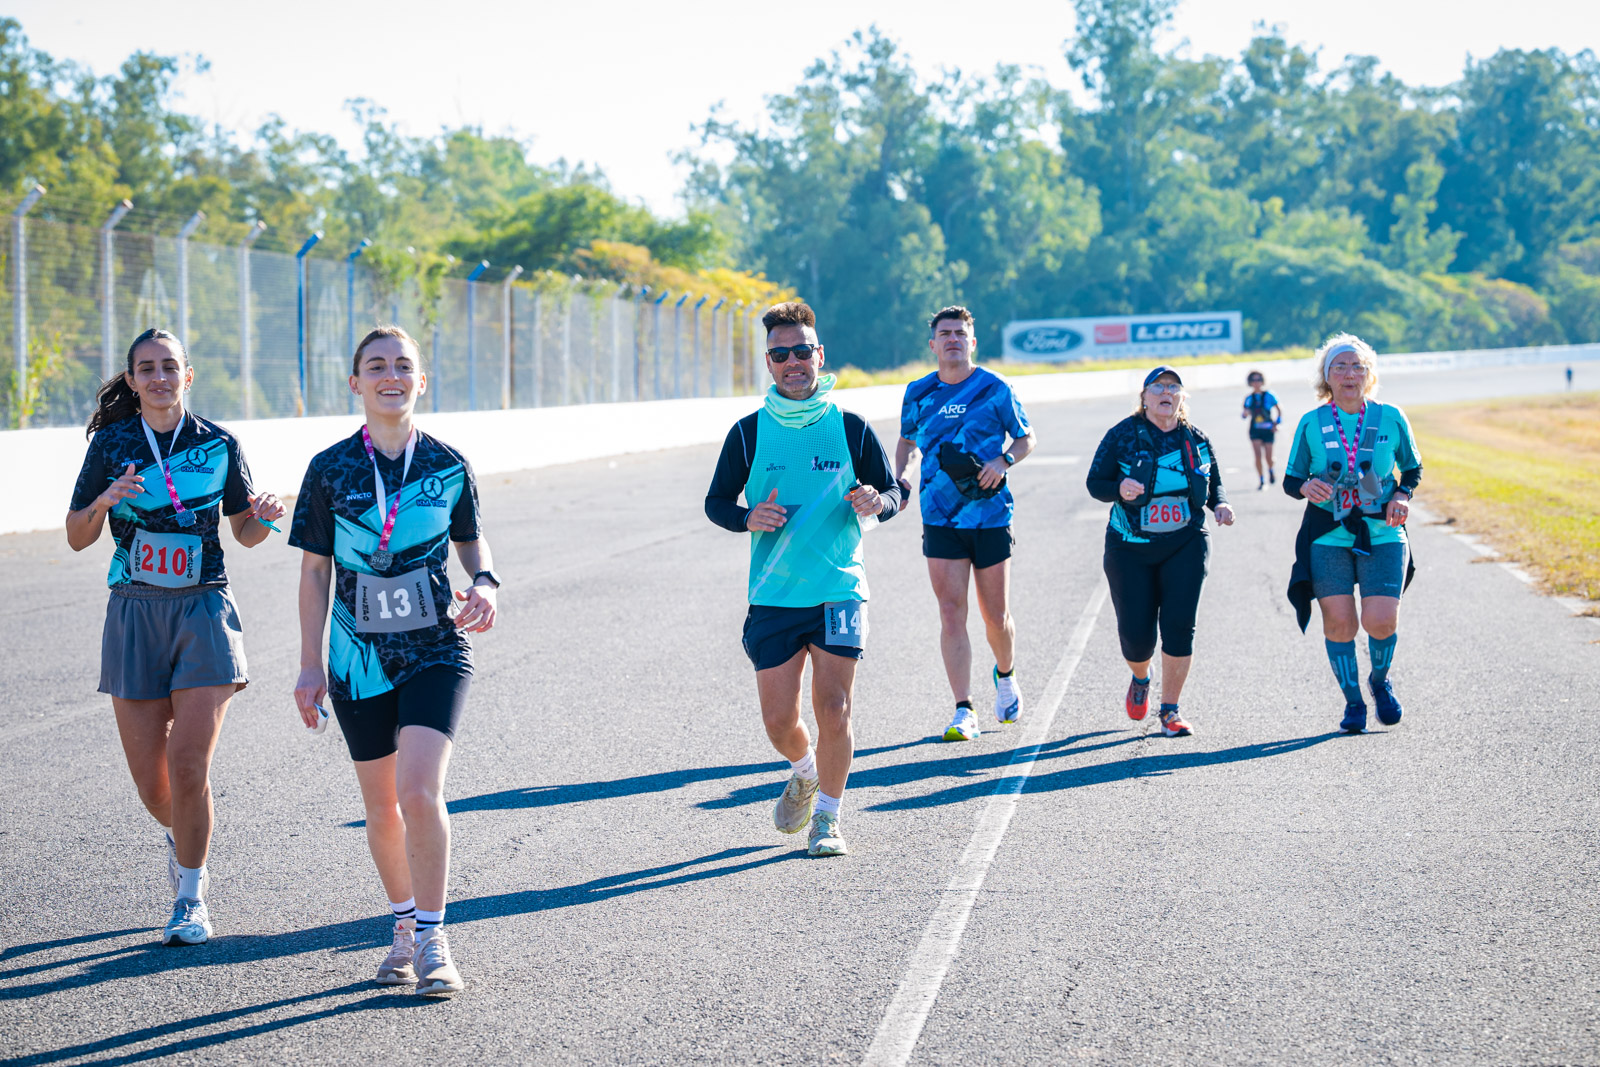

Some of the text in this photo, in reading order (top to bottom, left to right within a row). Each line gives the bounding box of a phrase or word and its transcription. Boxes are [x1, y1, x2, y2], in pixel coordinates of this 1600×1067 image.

[1022, 329, 1071, 350] Ford
[1136, 322, 1224, 340] LONG
[937, 404, 967, 415] ARG
[812, 456, 841, 471] km
[346, 492, 372, 500] INVICTO
[1341, 488, 1371, 510] 26
[1149, 504, 1182, 524] 266
[142, 544, 187, 576] 210
[186, 545, 194, 579] EXACTO
[377, 588, 411, 618] 13
[416, 582, 427, 618] EXACTO
